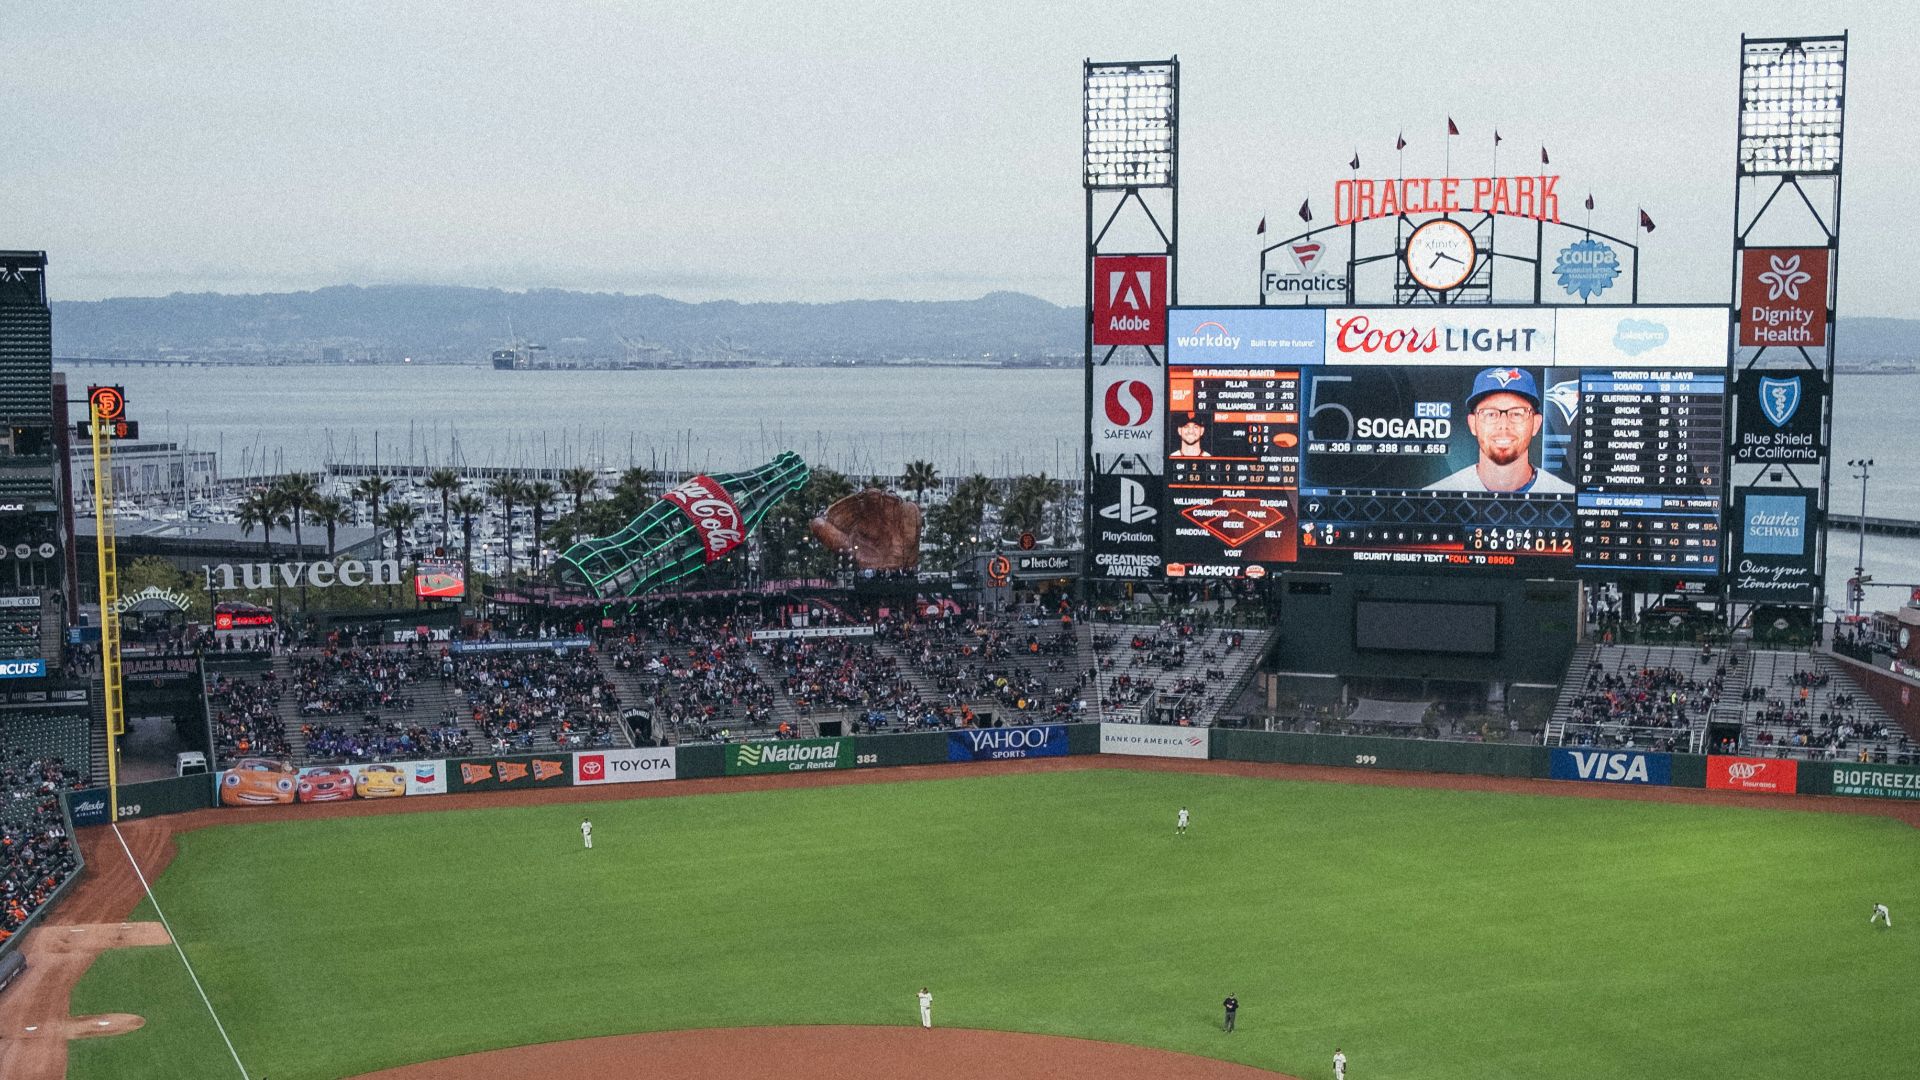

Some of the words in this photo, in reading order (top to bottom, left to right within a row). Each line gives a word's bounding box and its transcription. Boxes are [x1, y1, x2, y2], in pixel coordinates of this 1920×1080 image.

[1334, 177, 1460, 226] ORACLE
[1472, 175, 1561, 224] PARK
[1425, 239, 1458, 250] xfinity
[1562, 250, 1615, 268] coupa
[1265, 273, 1348, 291] Fanatics
[1752, 306, 1814, 326] Dignity
[1109, 315, 1151, 331] Adobe
[1335, 315, 1441, 354] Coors
[1445, 328, 1537, 353] LIGHT
[1754, 326, 1811, 341] Health
[1177, 333, 1241, 350] workday
[1208, 370, 1248, 378] FRANCISCO
[1249, 370, 1276, 378] GIANTS
[1612, 372, 1649, 380] TORONTO
[1650, 372, 1671, 380] BLUE
[1672, 373, 1694, 381] JAYS
[1613, 383, 1644, 392] SOGARD
[1218, 391, 1255, 399] CRAWFORD
[1601, 395, 1641, 403] GUERRERO
[1216, 403, 1256, 411] WILLIAMSON
[1307, 375, 1355, 441] 5
[1416, 402, 1451, 417] ERIC
[1614, 406, 1640, 415] SMOAK
[1356, 417, 1452, 438] SOGARD
[1611, 418, 1643, 427] GRICHUK
[1659, 419, 1669, 427] RF
[1104, 429, 1154, 440] SAFEWAY
[1613, 430, 1640, 438] GALVIS
[1743, 432, 1771, 445] Blue
[1774, 432, 1813, 446] Shield
[1308, 443, 1325, 451] AVG
[1658, 442, 1668, 450] LF
[1614, 453, 1637, 461] DAVIS
[1657, 453, 1668, 462] CF
[1738, 445, 1752, 458] of
[1755, 446, 1817, 459] California
[1610, 465, 1640, 473] JANSEN
[1703, 466, 1710, 474] K
[1605, 476, 1645, 485] THORNTON
[1222, 490, 1246, 498] PILLAR
[1173, 498, 1214, 506] WILLIAMSON
[1596, 498, 1613, 506] ERIC
[1613, 498, 1644, 507] SOGARD
[1712, 500, 1719, 508] R
[1192, 509, 1229, 518] CRAWFORD
[1309, 504, 1320, 512] F7
[1600, 509, 1619, 517] STATS
[1750, 510, 1800, 526] charles
[1326, 524, 1333, 534] 3
[1600, 520, 1611, 528] 20
[1670, 522, 1679, 531] 12
[1175, 528, 1211, 537] SANDOVAL
[1264, 530, 1282, 538] BELT
[1750, 526, 1799, 538] SCHWAB
[1102, 531, 1153, 545] PlayStation
[1326, 535, 1333, 545] 0
[1600, 536, 1610, 544] 72
[1668, 538, 1680, 546] 40
[41, 546, 53, 554] 44
[1535, 540, 1545, 552] 0
[1549, 540, 1558, 553] 1
[1562, 541, 1573, 553] 2
[1095, 554, 1161, 567] GREATNESS
[1353, 552, 1391, 561] SECURITY
[1393, 553, 1422, 562] ISSUE?
[1422, 554, 1444, 563] TEXT
[1474, 555, 1486, 564] TO
[1600, 552, 1610, 560] 22
[1048, 556, 1069, 569] Coffee
[202, 558, 404, 591] nuveen
[1188, 564, 1241, 577] JACKPOT
[1739, 559, 1770, 573] Own
[1770, 563, 1808, 581] your
[1738, 576, 1810, 590] tomorrow
[113, 586, 194, 613] Ghirardelli
[968, 727, 1049, 753] YAHOO!
[1105, 735, 1129, 744] BANK
[1130, 736, 1141, 744] OF
[1142, 736, 1184, 746] AMERICA
[761, 742, 841, 763] National
[992, 750, 1026, 760] SPORTS
[856, 754, 879, 764] 382
[1355, 754, 1377, 765] 399
[610, 758, 671, 773] TOYOTA
[788, 762, 804, 771] Car
[806, 760, 837, 770] Rental
[1567, 751, 1649, 782] VISA
[1730, 763, 1753, 778] AAA
[1742, 780, 1777, 789] Insurance
[1863, 788, 1885, 796] COOL
[1887, 789, 1903, 797] THE
[75, 800, 105, 813] Alaska
[118, 804, 142, 817] 339
